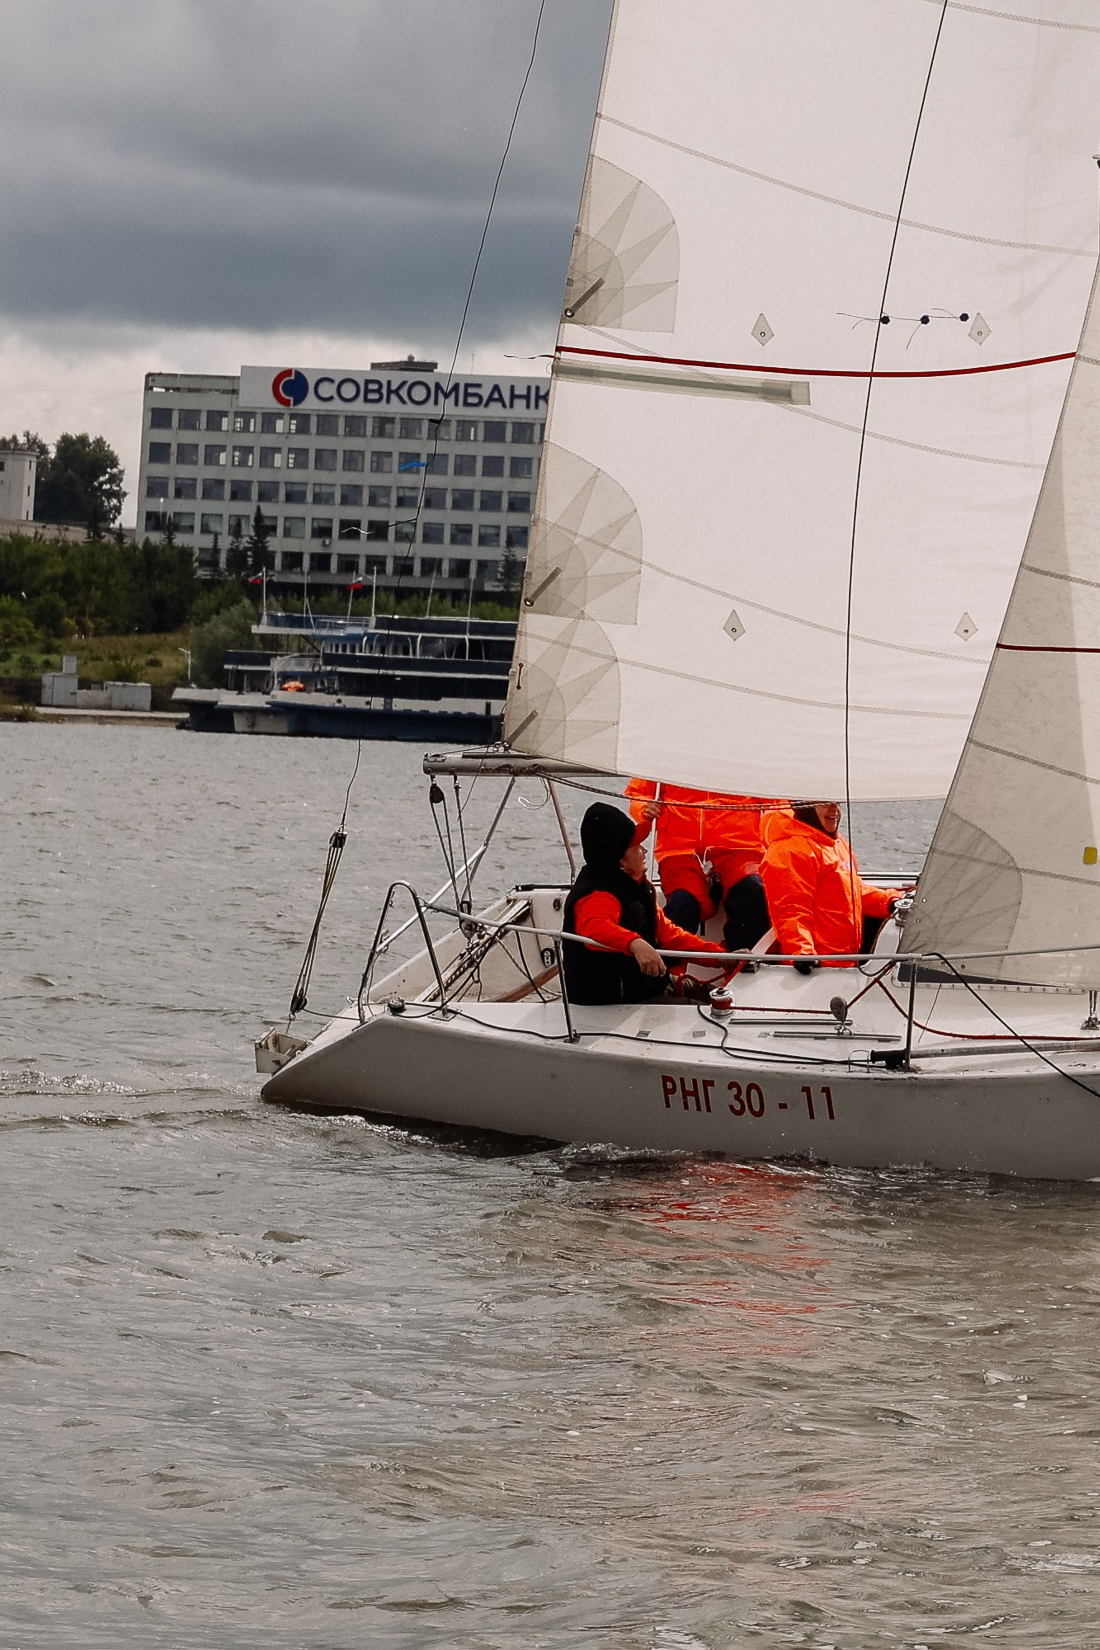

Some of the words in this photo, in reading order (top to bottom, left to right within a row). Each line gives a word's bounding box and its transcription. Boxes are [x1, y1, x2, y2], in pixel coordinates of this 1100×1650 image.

[661, 1074, 715, 1113] РНГ
[727, 1080, 765, 1118] 30
[801, 1085, 835, 1120] 11
